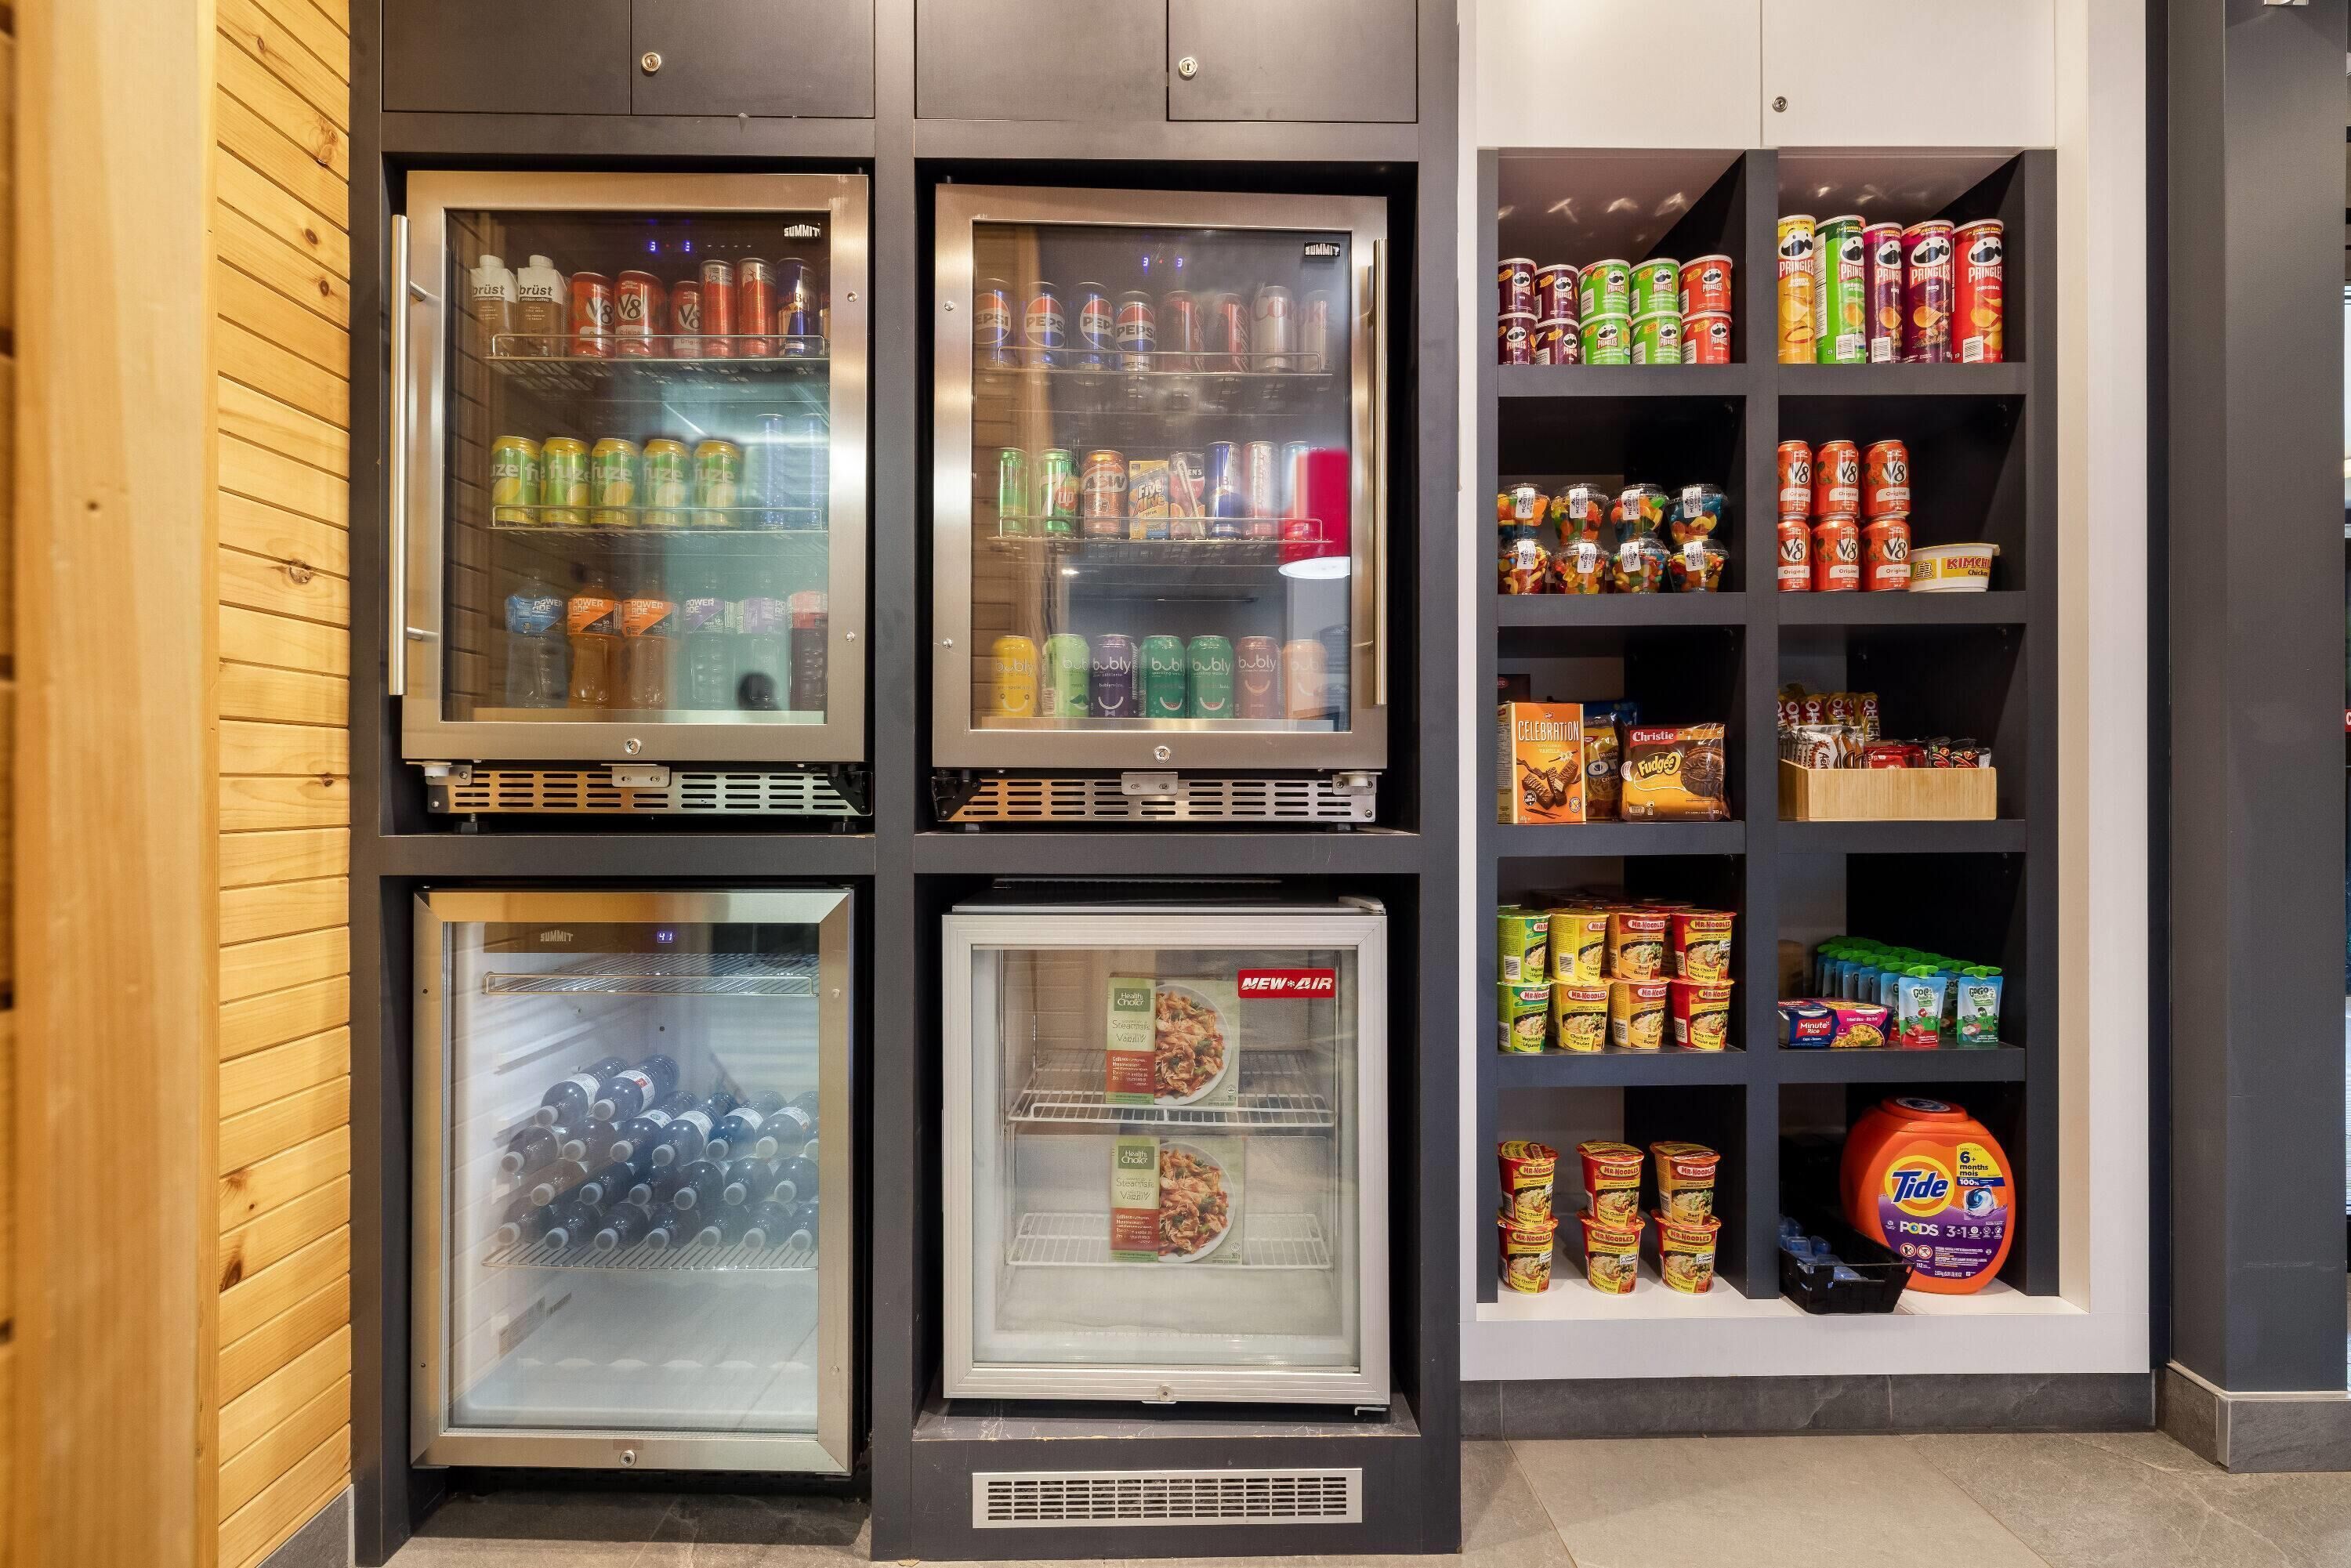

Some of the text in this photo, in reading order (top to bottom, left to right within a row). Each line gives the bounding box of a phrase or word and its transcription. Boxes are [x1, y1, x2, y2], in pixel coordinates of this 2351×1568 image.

[784, 224, 820, 237] SUMMIT
[1305, 243, 1340, 256] SUMMIT
[1143, 257, 1183, 267] 3 3
[1780, 259, 1814, 279] PRINGLES
[1911, 265, 1951, 286] PRINGLES
[520, 284, 552, 296] brüst
[1607, 284, 1625, 294] PRINGLES
[1702, 283, 1722, 292] PRINGLES
[588, 297, 613, 325] V8
[618, 293, 642, 320] V8
[679, 304, 701, 328] V8
[1597, 337, 1617, 349] PRINGLES
[1790, 459, 1809, 483] V8
[1839, 459, 1857, 483] V8
[1882, 458, 1905, 483] V8
[1138, 479, 1163, 499] Five
[1781, 537, 1804, 560] V8
[1837, 538, 1857, 559] V8
[1883, 535, 1907, 559] V8
[534, 599, 563, 607] POWER
[631, 600, 664, 609] POWER
[996, 659, 1034, 677] bubly
[1093, 657, 1131, 675] bubly
[1151, 657, 1185, 675] bubly
[1193, 657, 1230, 675] bubly
[1238, 654, 1276, 672] bubly
[1632, 731, 1674, 742] Christie
[540, 931, 573, 942] SUMMIT
[1693, 1166, 1715, 1175] NOODLES
[1891, 1171, 1950, 1204] Tide
[1607, 1233, 1633, 1242] NOODLES
[1681, 1233, 1710, 1241] NOODLES
[1900, 1221, 1939, 1237] PODS
